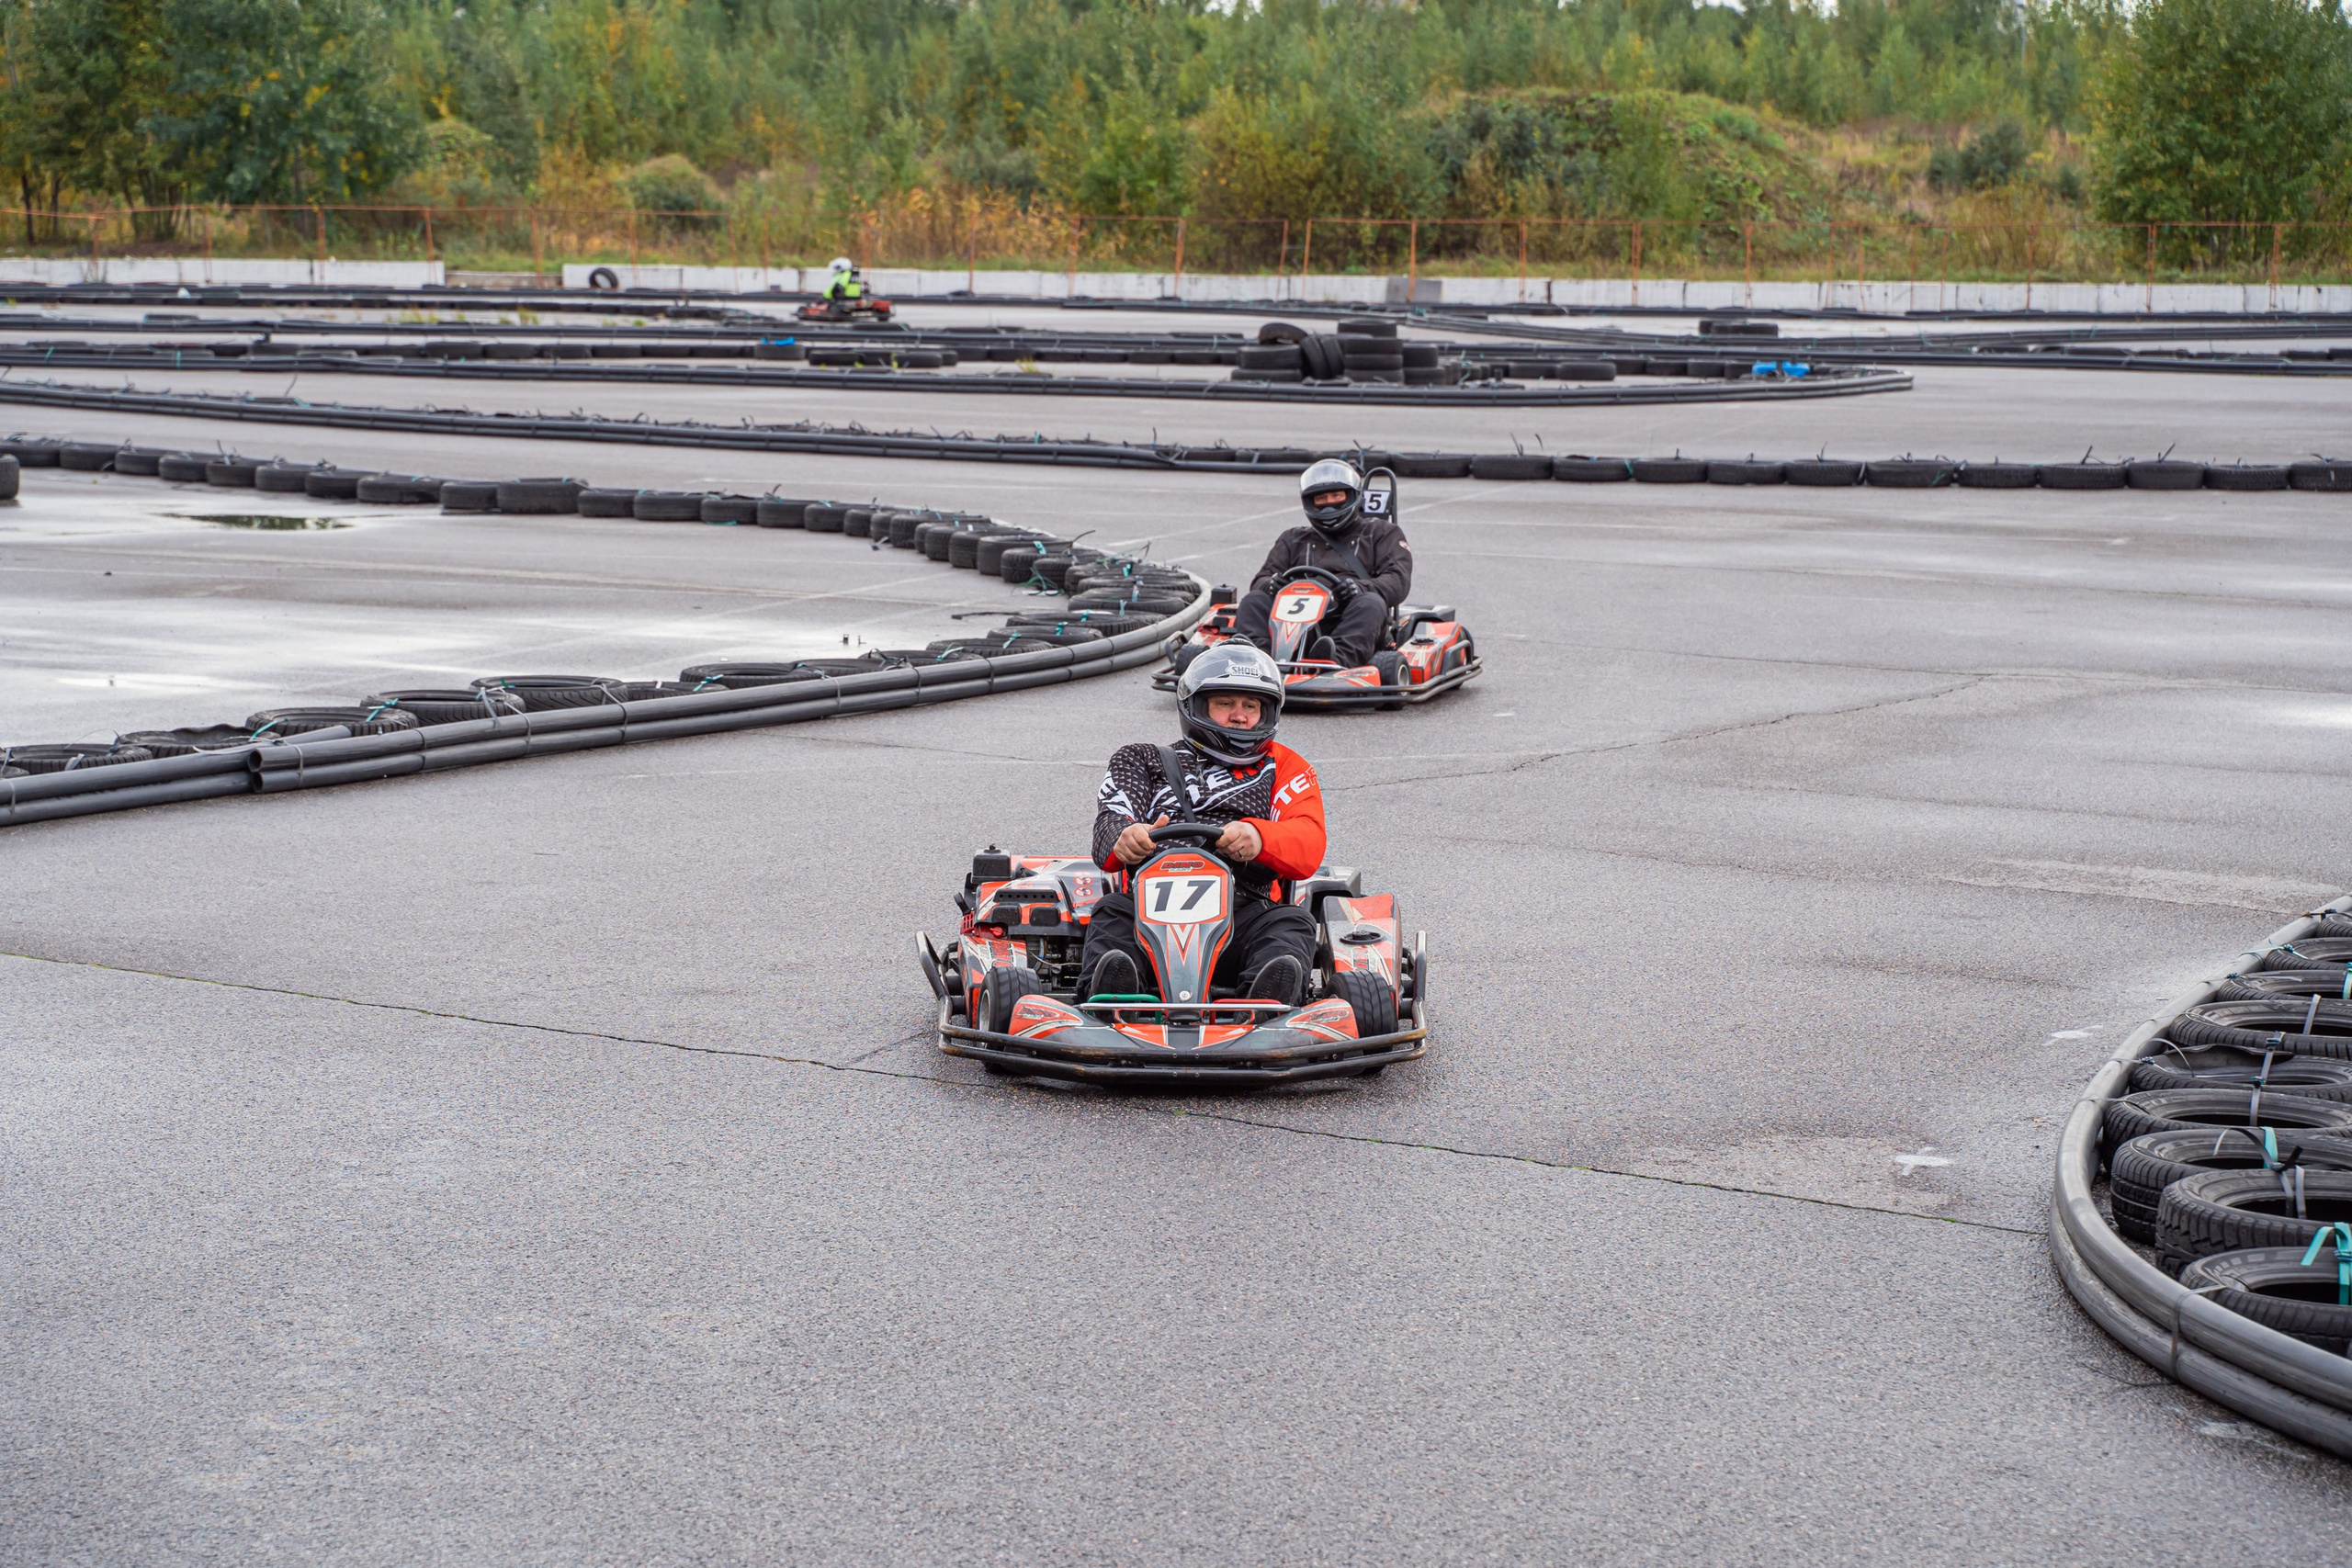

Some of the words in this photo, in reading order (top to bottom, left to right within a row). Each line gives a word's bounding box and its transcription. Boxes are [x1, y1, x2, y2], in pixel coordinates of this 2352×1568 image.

[1367, 493, 1382, 512] 5
[1286, 597, 1310, 615] 5
[1231, 666, 1259, 677] SHOEI
[1160, 861, 1204, 870] DINO
[1154, 880, 1216, 912] 17
